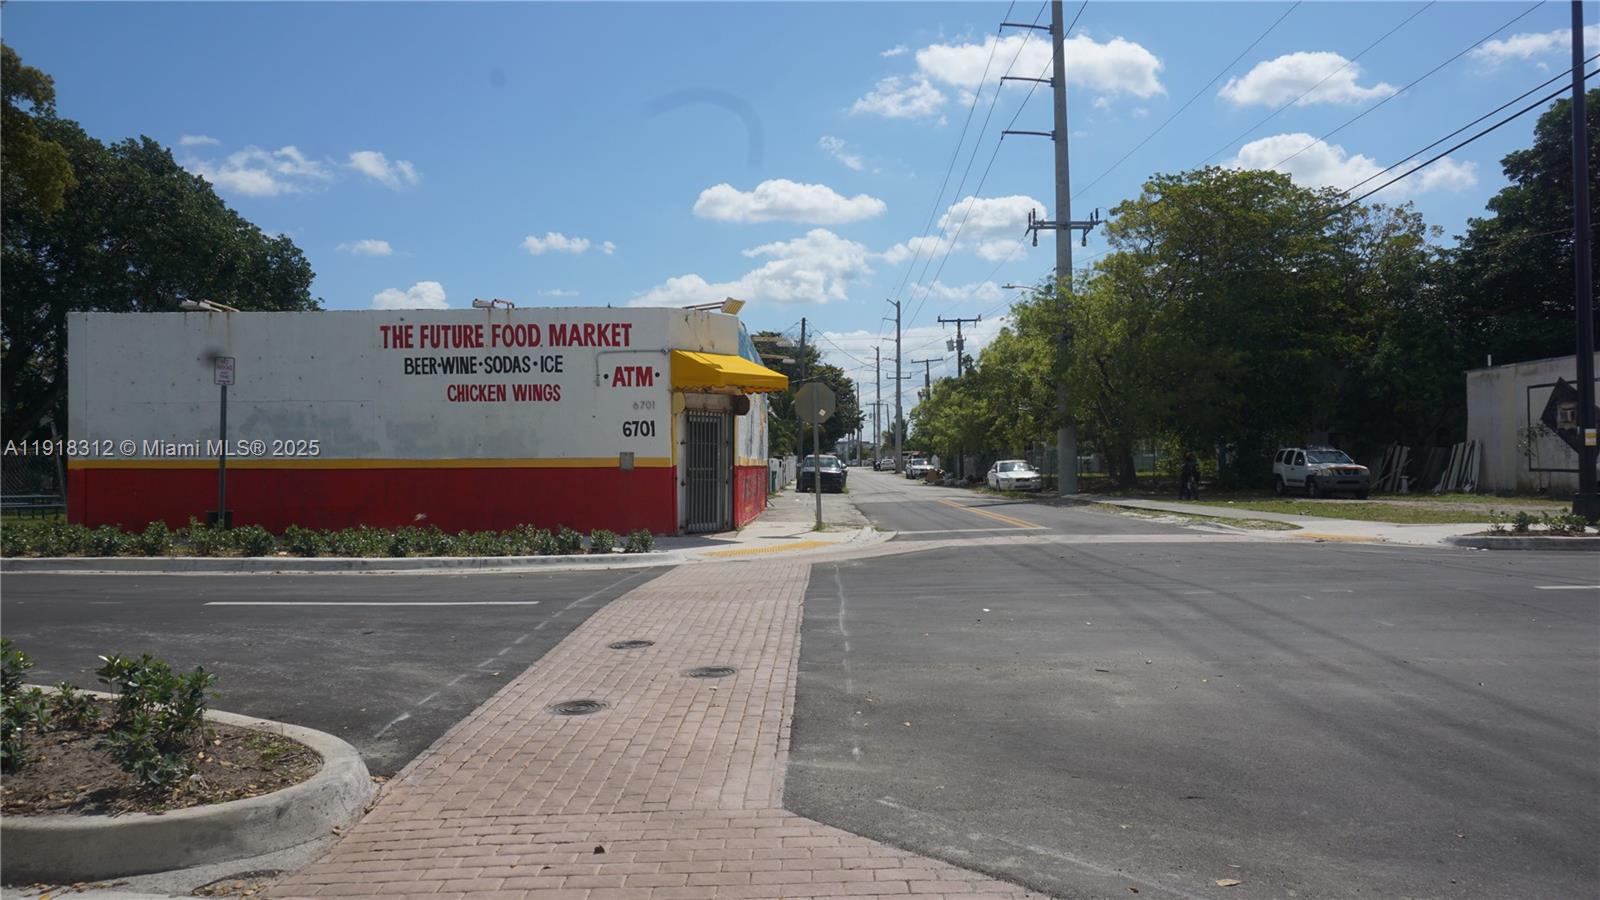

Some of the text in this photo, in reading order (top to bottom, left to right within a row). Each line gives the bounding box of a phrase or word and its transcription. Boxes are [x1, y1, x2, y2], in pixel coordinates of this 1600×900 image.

[379, 325, 414, 349] THE
[419, 324, 484, 349] FUTURE
[548, 322, 632, 347] MARKET
[540, 355, 563, 373] ICE
[612, 366, 653, 387] ATM
[447, 384, 561, 402] CHICKEN WINGS
[633, 400, 655, 410] 6701
[622, 420, 655, 437] 6701
